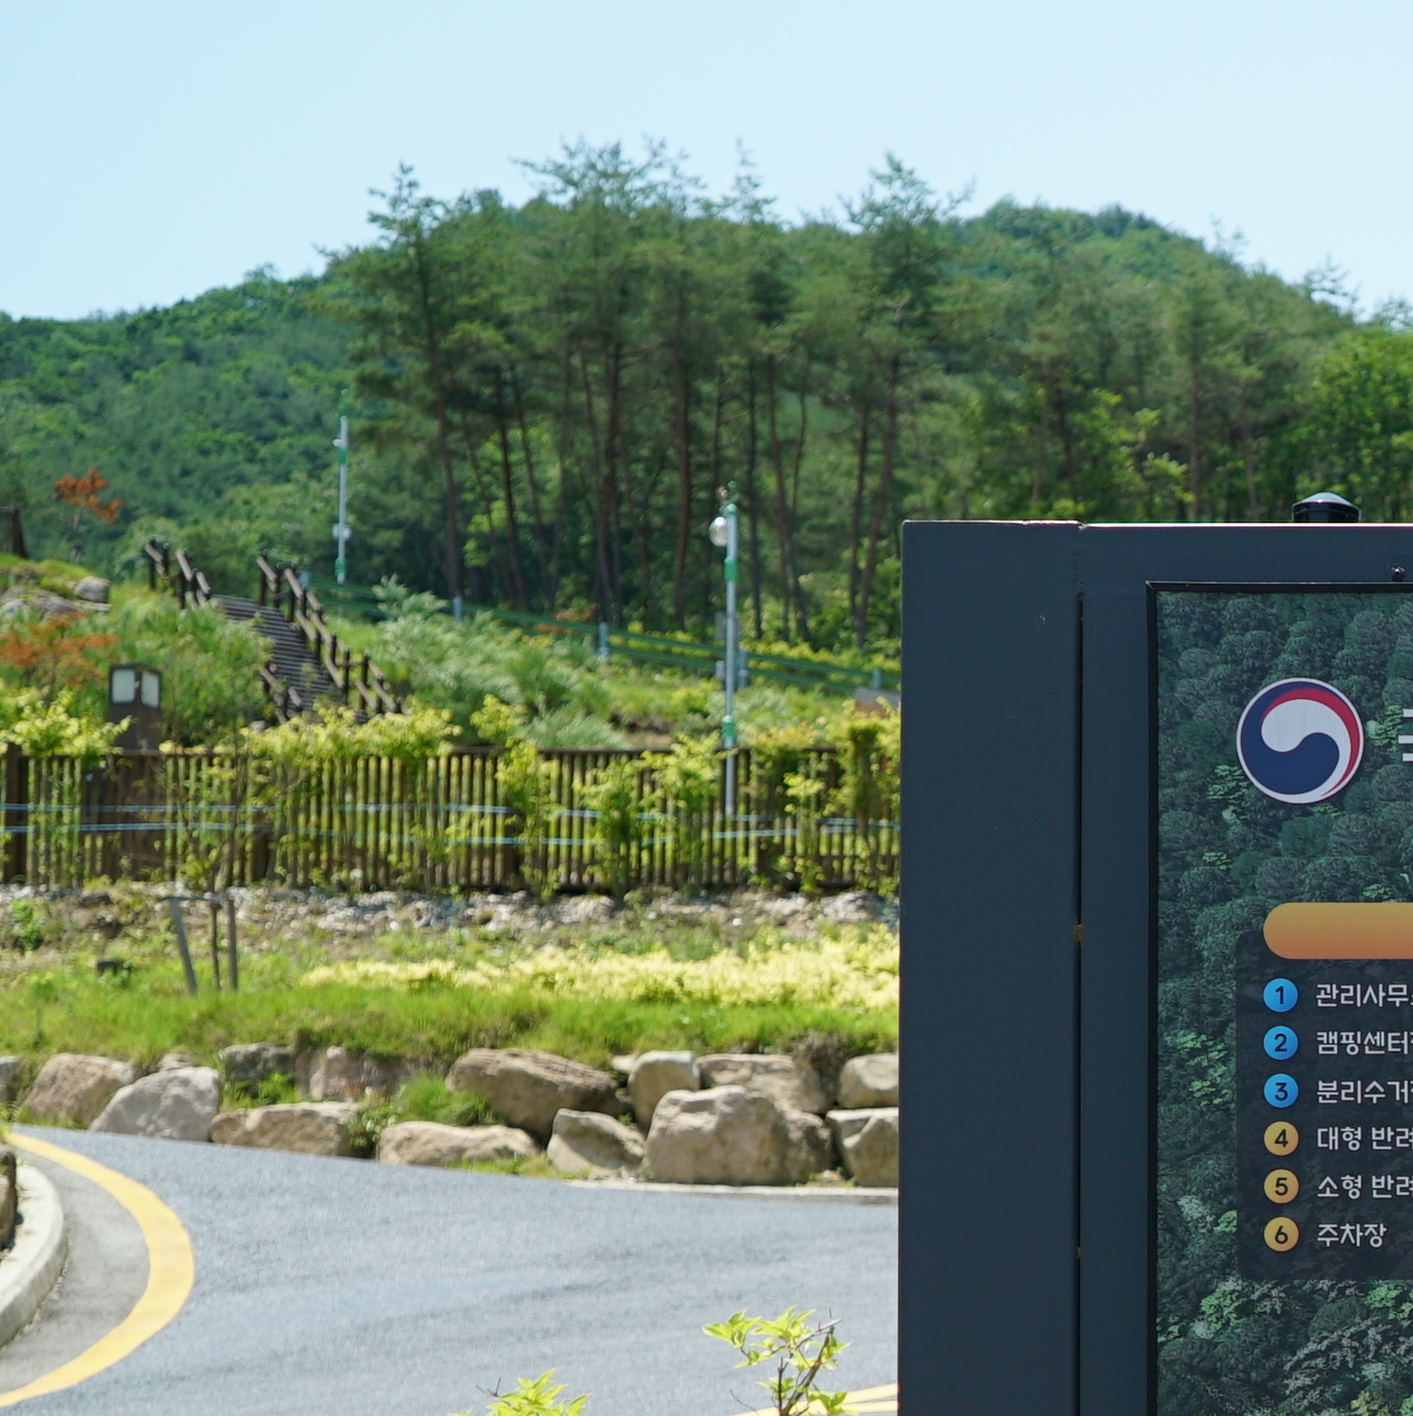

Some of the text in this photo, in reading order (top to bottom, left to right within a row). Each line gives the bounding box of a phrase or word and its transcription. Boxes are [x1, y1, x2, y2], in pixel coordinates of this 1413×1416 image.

[1275, 985, 1285, 1005] 1
[1274, 1033, 1288, 1053] 2
[1274, 1082, 1289, 1102] 3
[1274, 1128, 1289, 1148] 4
[1317, 1126, 1362, 1151] 대형
[1274, 1177, 1289, 1197] 5
[1317, 1174, 1362, 1200] 소형
[1274, 1223, 1387, 1248] 6 주차장
